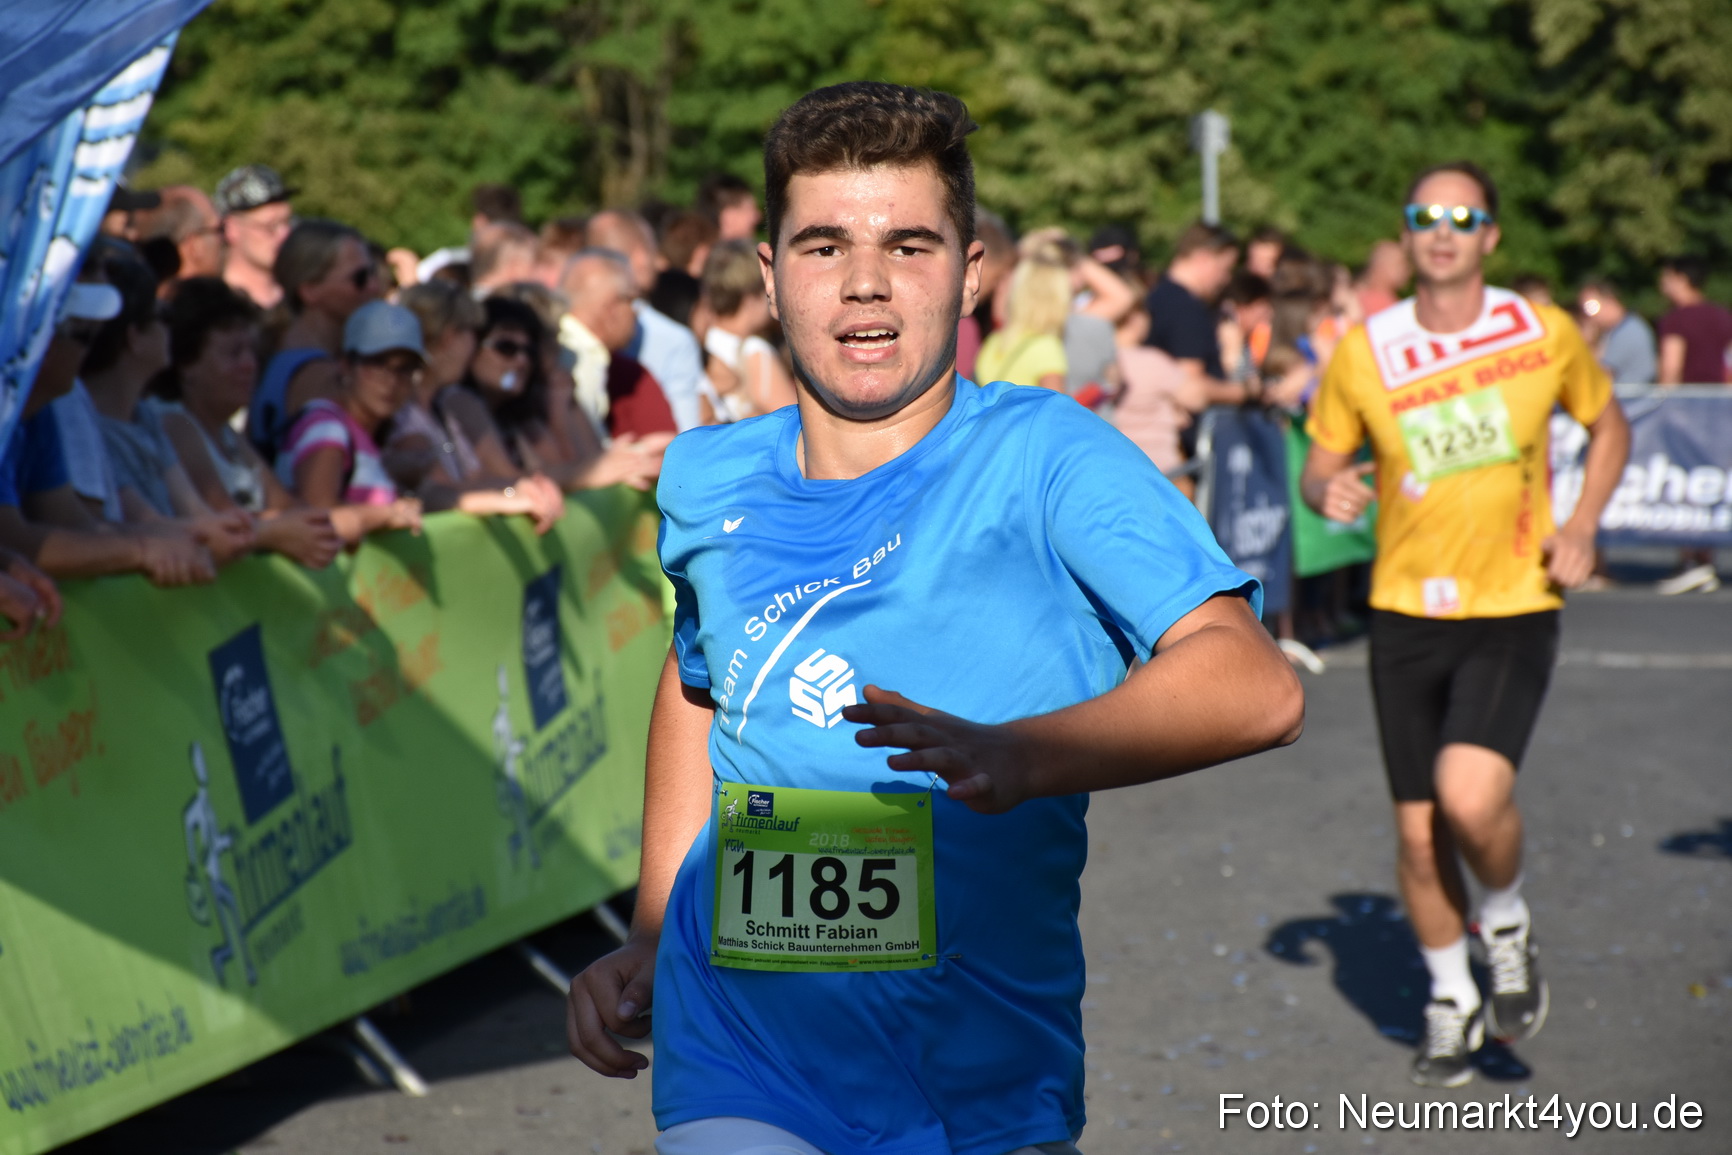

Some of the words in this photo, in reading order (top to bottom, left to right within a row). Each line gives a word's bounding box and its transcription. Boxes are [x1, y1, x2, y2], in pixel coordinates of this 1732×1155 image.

[1390, 378, 1463, 416] MAX
[1421, 416, 1498, 461] 1235
[744, 576, 841, 641] Schick
[852, 533, 902, 579] Bau
[736, 812, 801, 832] firmenlauf
[808, 832, 850, 848] 2018
[733, 850, 900, 921] 1185
[718, 935, 749, 949] Matthias
[751, 939, 785, 951] Schick
[788, 942, 882, 953] Bauunternehmen
[885, 940, 920, 951] GmbH
[745, 920, 810, 939] Schmitt
[816, 924, 878, 940] Fabian
